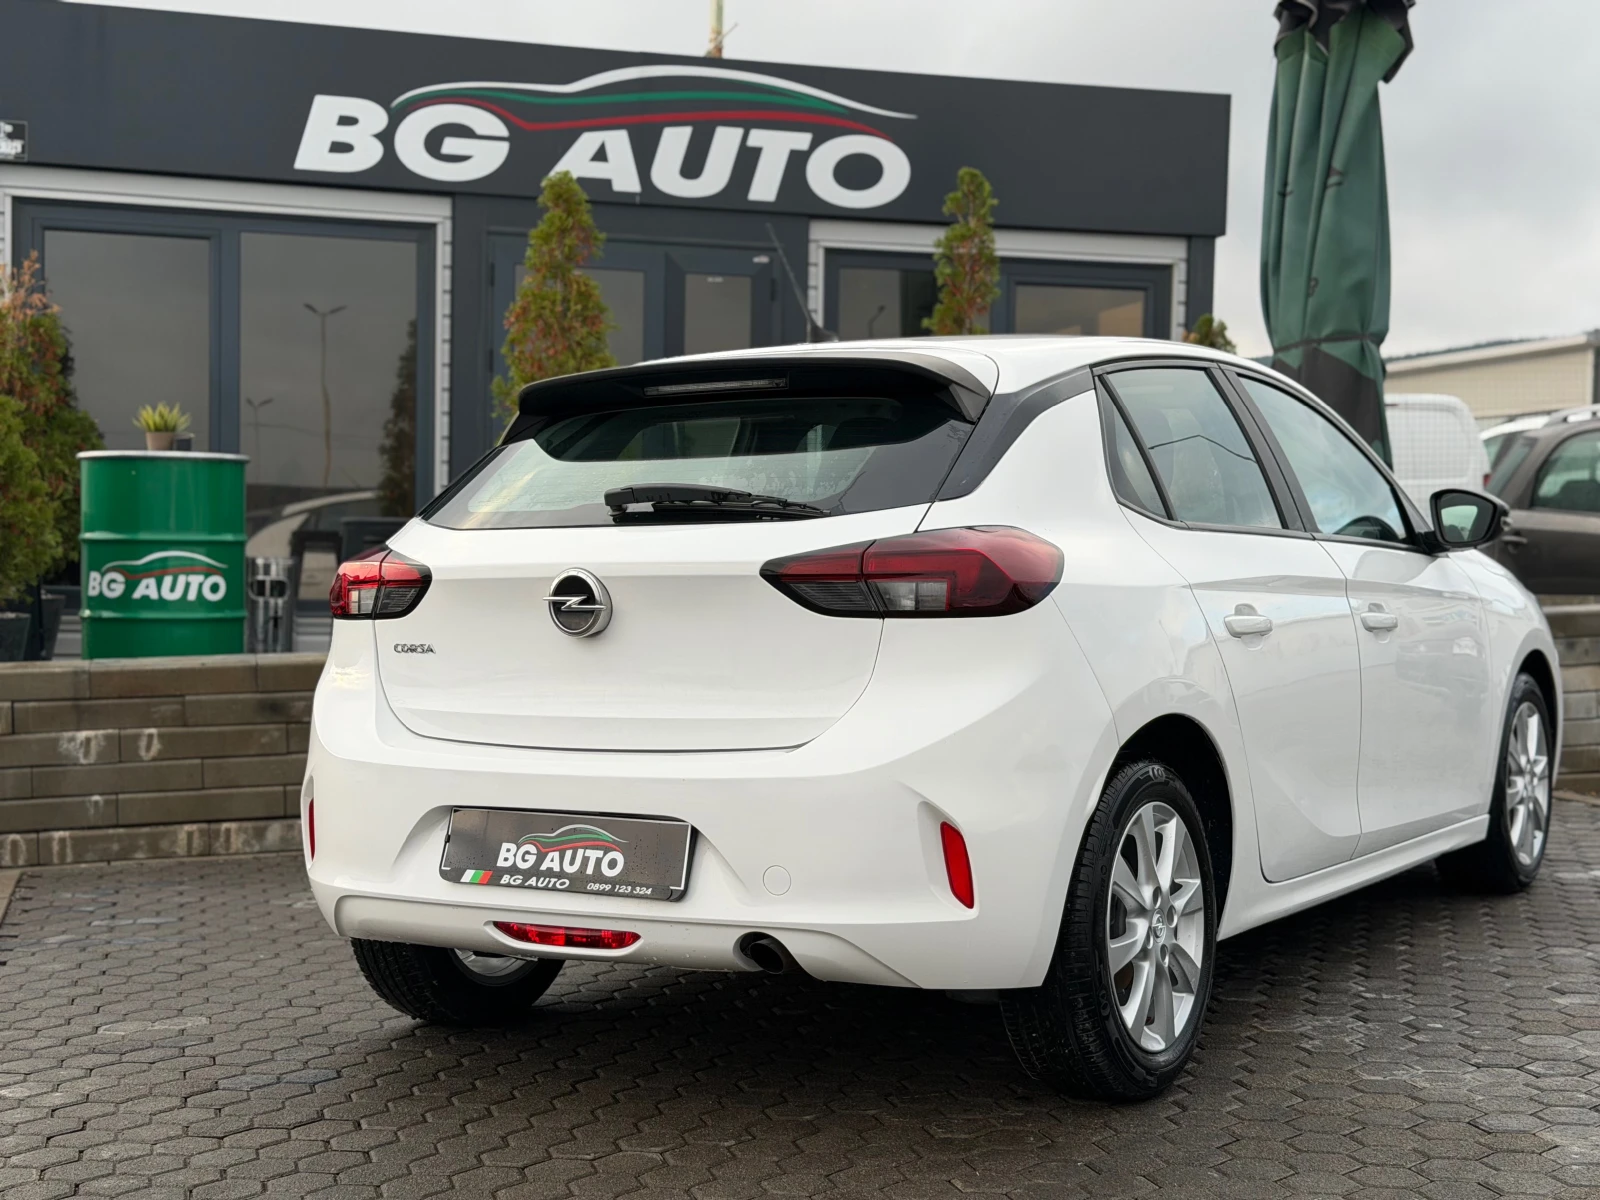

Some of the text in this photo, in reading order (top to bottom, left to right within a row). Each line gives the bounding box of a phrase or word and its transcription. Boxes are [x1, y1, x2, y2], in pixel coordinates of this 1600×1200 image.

[293, 94, 912, 209] BG AUTO
[87, 570, 227, 602] BG AUTO
[393, 643, 437, 655] CORSA
[496, 842, 625, 878] BG AUTO
[499, 874, 570, 890] BG AUTO
[586, 882, 653, 896] 0899 123 324
